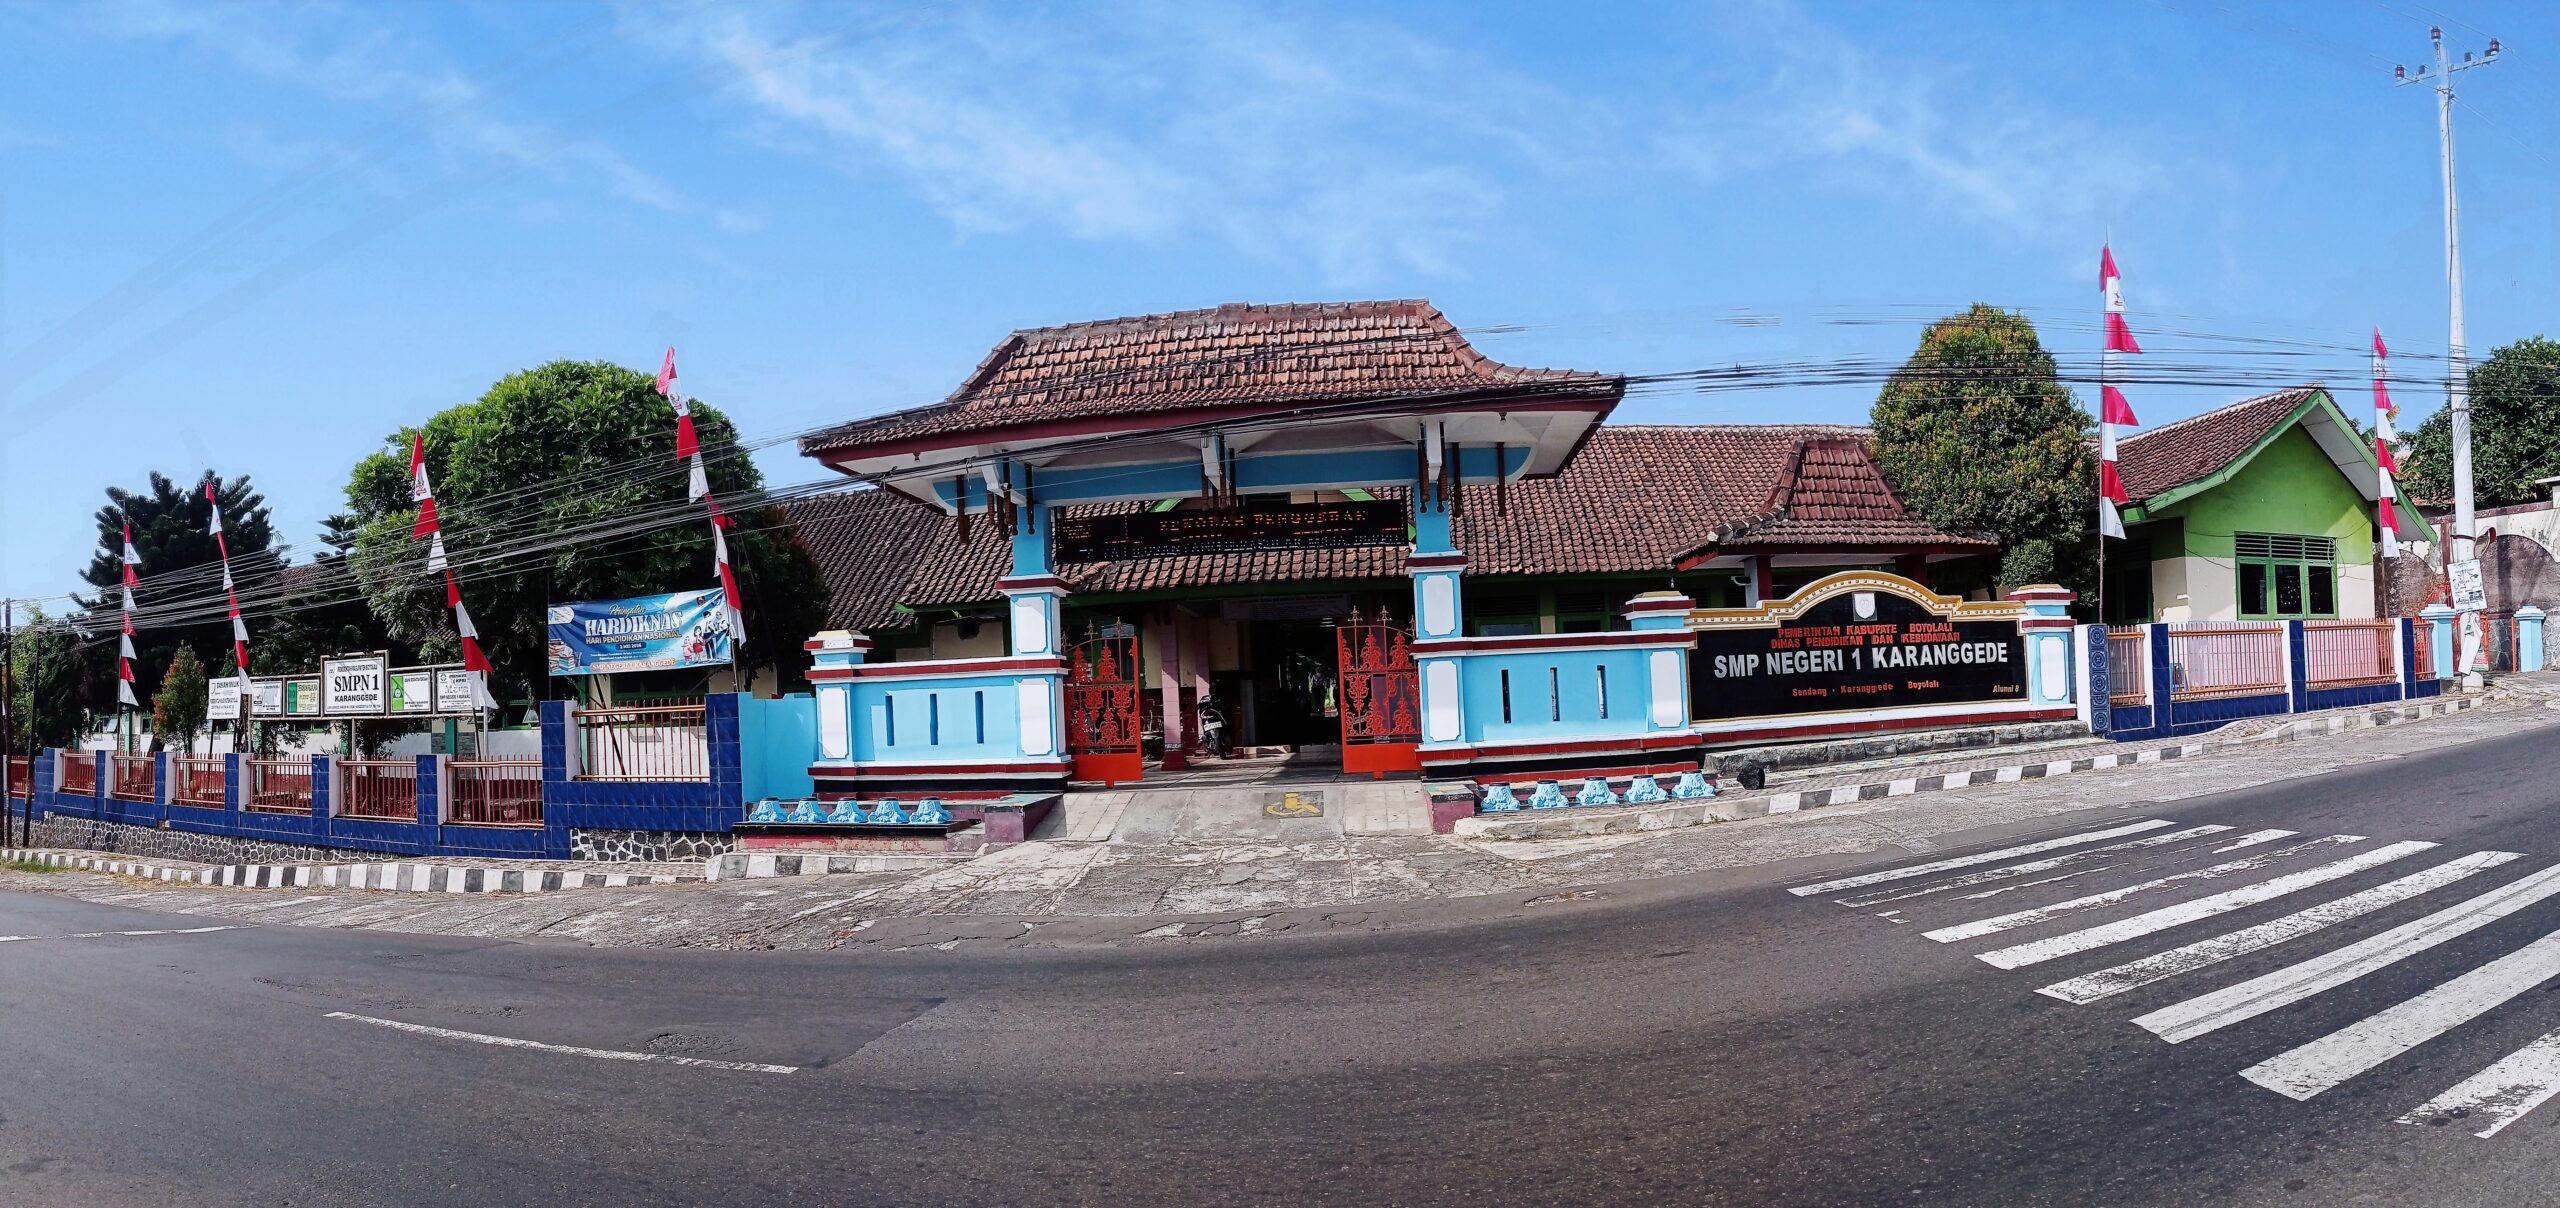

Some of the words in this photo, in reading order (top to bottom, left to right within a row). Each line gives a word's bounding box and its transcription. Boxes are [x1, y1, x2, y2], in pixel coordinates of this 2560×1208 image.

[585, 611, 683, 636] HARDIKNAS
[1777, 626, 1841, 638] PEMERINTAH
[1846, 624, 1898, 635] KABUPATE
[1909, 622, 1953, 633] BOYOLALI
[586, 635, 602, 645] HARI
[603, 632, 642, 643] PENDIDIKAN
[644, 630, 682, 641] NASIONAL
[1771, 638, 1801, 649] DINAS
[1806, 635, 1864, 648] PENDIDIKAN
[1871, 634, 1894, 645] DAN
[1901, 632, 1961, 644] KEBUDAYAAN
[1713, 653, 1760, 679] SMP
[1765, 648, 1844, 676] NEGERI
[1851, 647, 1861, 670] 1
[1871, 642, 2009, 669] KARANGGEDE
[334, 674, 370, 692] SMPN
[372, 673, 379, 691] 1
[1792, 687, 1827, 697] Sendang
[1840, 683, 1894, 694] Karanggede
[1907, 680, 1940, 690] Boyolali
[1992, 684, 2014, 693] Alumni
[334, 693, 378, 702] KARANGGEDE
